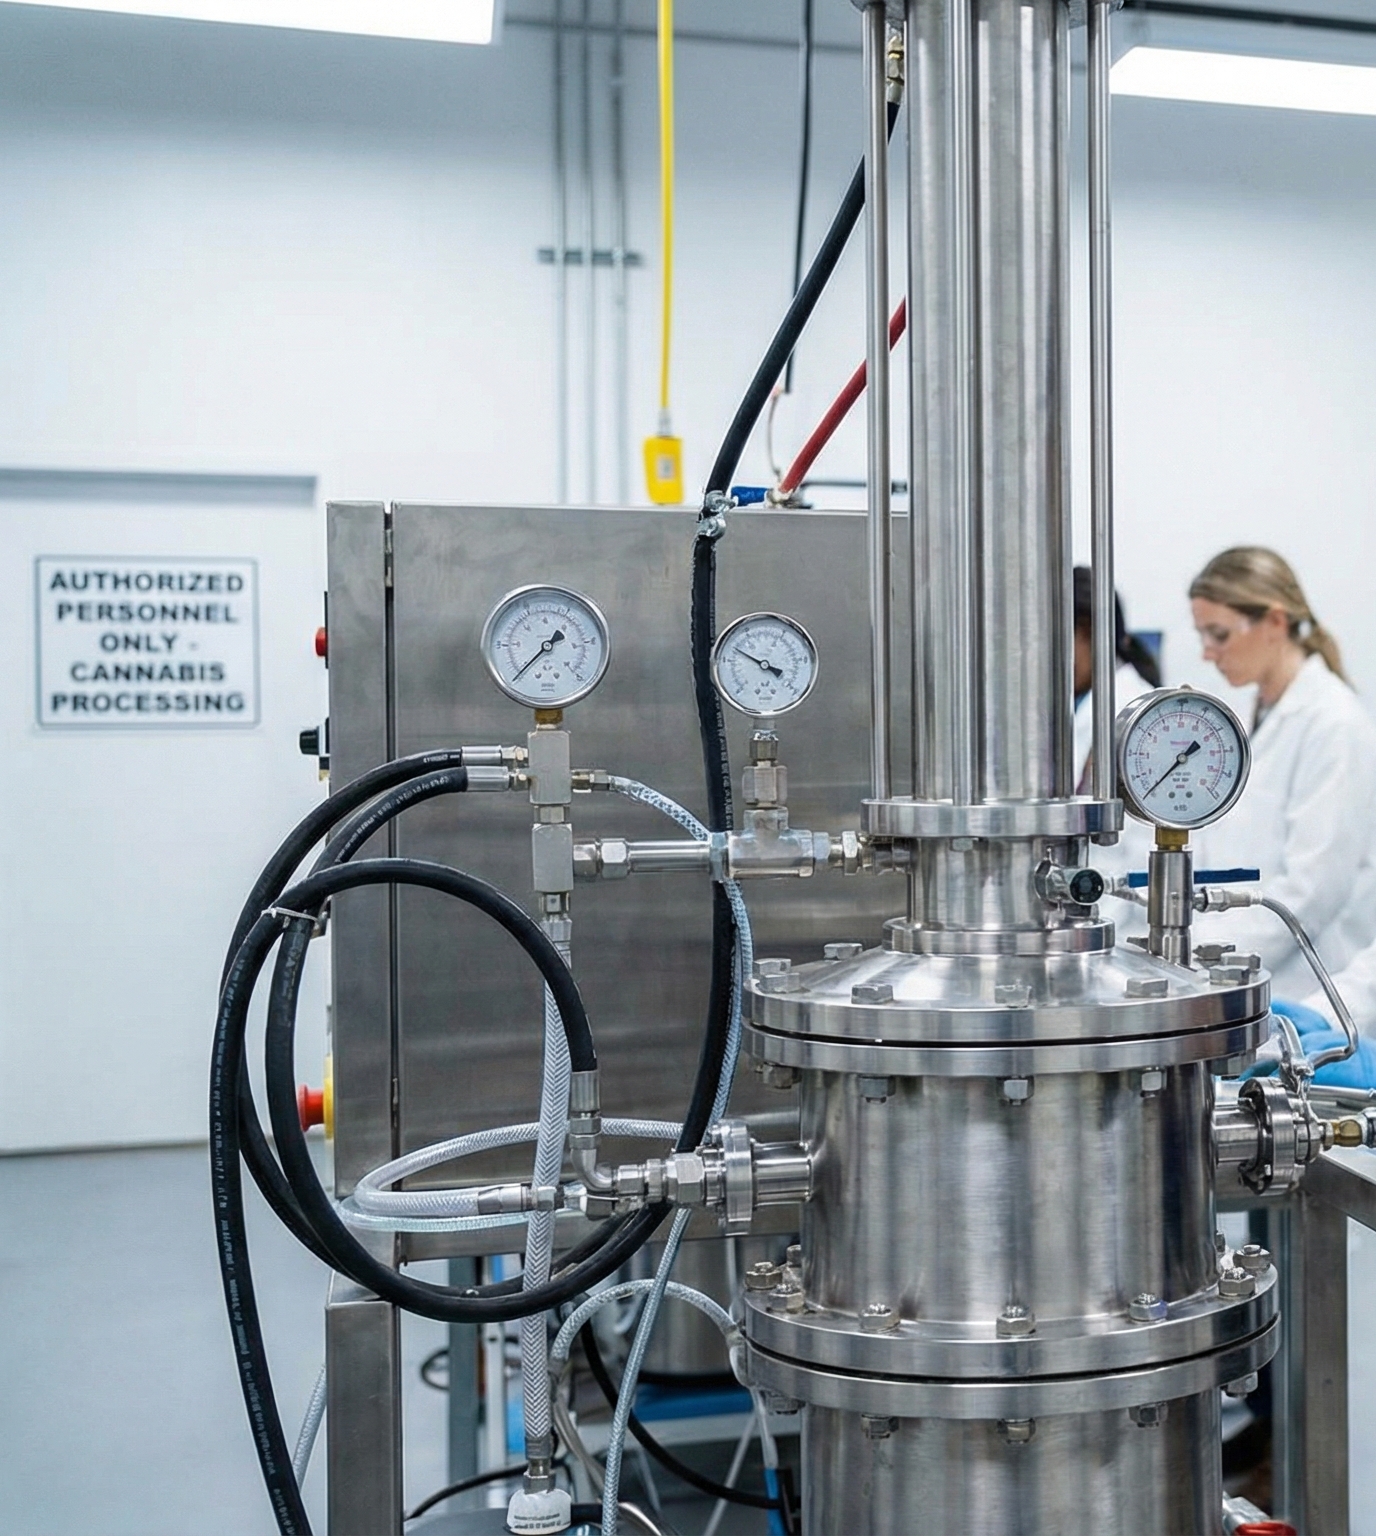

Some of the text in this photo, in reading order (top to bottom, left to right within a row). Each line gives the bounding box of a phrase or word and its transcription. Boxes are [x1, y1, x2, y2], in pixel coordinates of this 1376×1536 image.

[50, 571, 244, 592] AUTHORIZED
[57, 602, 238, 623] PERSONNEL
[100, 633, 178, 652] ONLY
[71, 662, 225, 682] CANNABIS
[52, 693, 245, 713] PROCESSING
